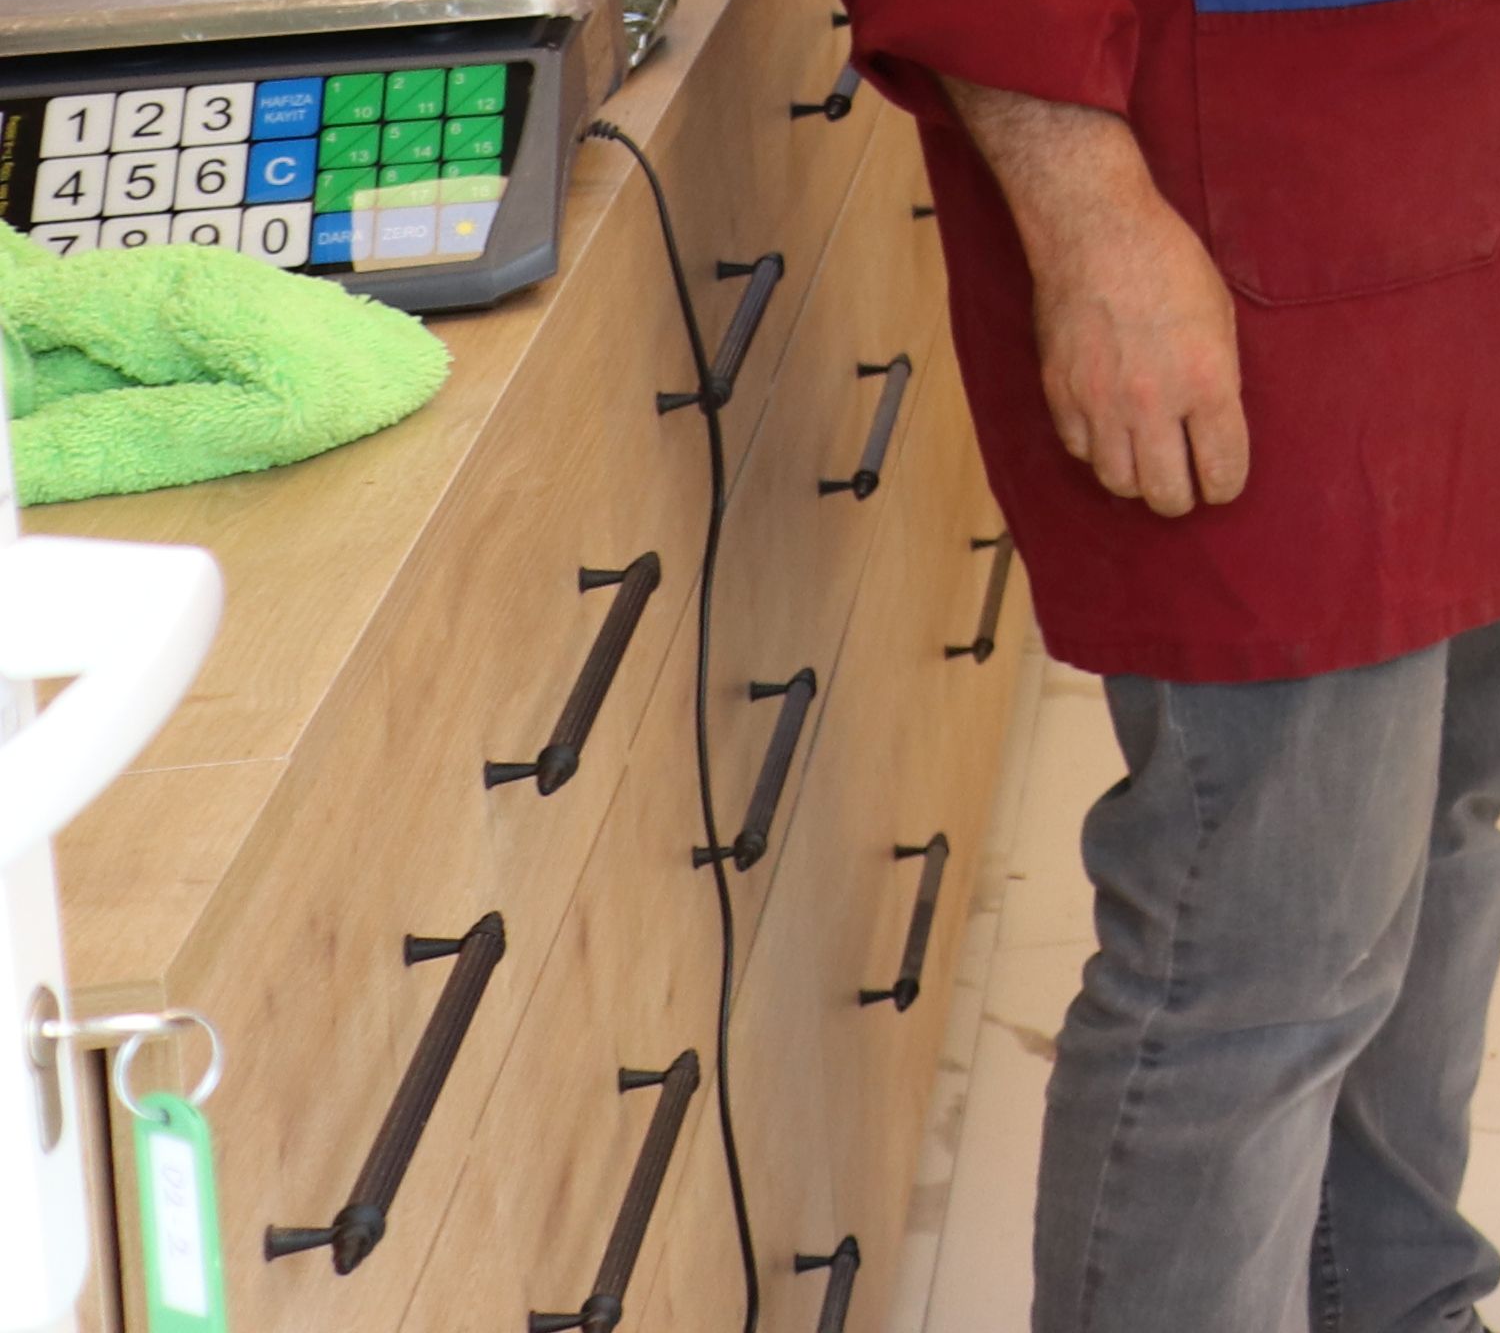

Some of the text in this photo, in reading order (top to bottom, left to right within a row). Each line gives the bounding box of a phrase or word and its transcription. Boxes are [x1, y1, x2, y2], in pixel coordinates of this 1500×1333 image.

[393, 78, 405, 89] 2
[455, 73, 465, 84] 3
[333, 82, 341, 92] 1
[261, 93, 314, 109] HAFIZA
[477, 98, 496, 110] 12
[203, 97, 232, 131] 3
[353, 106, 373, 118] 10
[418, 102, 435, 114] 11
[132, 102, 165, 138] 2
[264, 109, 308, 124] KAYIT
[68, 108, 88, 142] 1
[451, 123, 461, 134] 6
[326, 132, 336, 143] 4
[389, 128, 400, 138] 5
[412, 146, 433, 158] 14
[473, 142, 493, 154] 15
[350, 150, 370, 162] 13
[198, 159, 227, 194] 6
[264, 157, 297, 185] C
[386, 170, 397, 182] 8
[125, 164, 157, 200] 5
[323, 175, 333, 186] 7
[53, 170, 85, 205] 4
[262, 218, 289, 254] 0
[382, 225, 427, 241] ZERO
